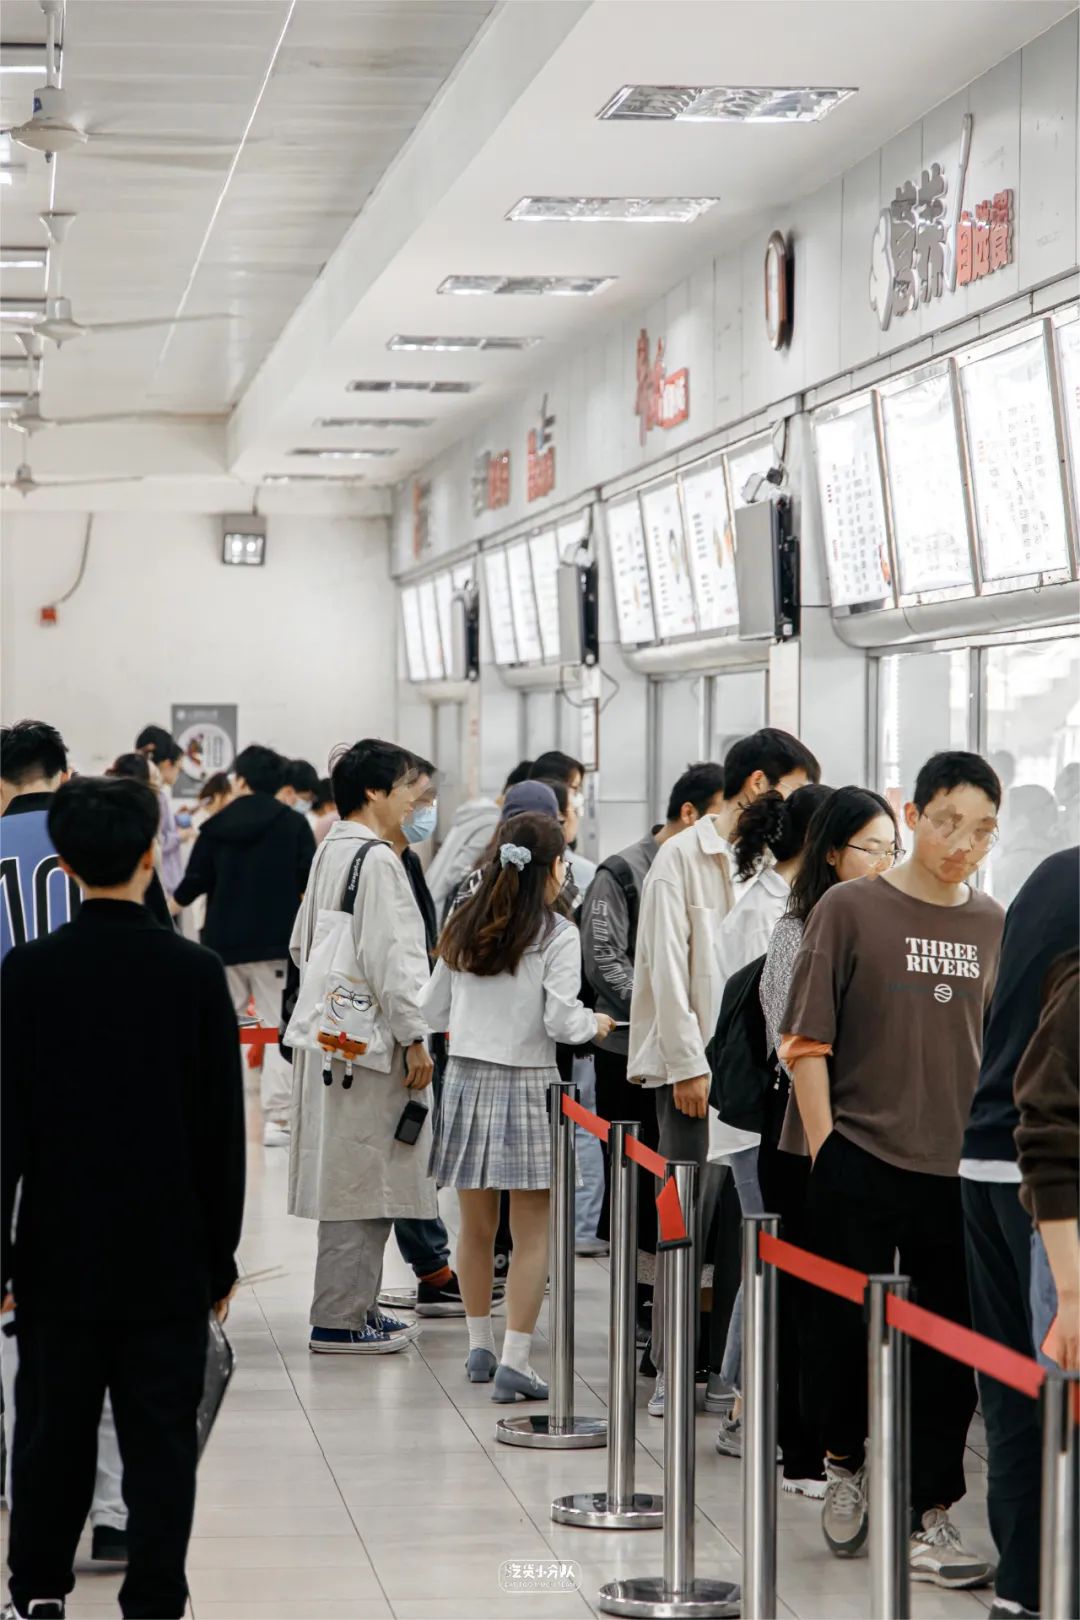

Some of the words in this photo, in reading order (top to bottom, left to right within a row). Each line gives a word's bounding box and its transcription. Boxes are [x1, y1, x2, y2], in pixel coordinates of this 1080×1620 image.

[0, 853, 84, 947] 10
[905, 937, 978, 961] THREE
[905, 954, 980, 979] RIVERS
